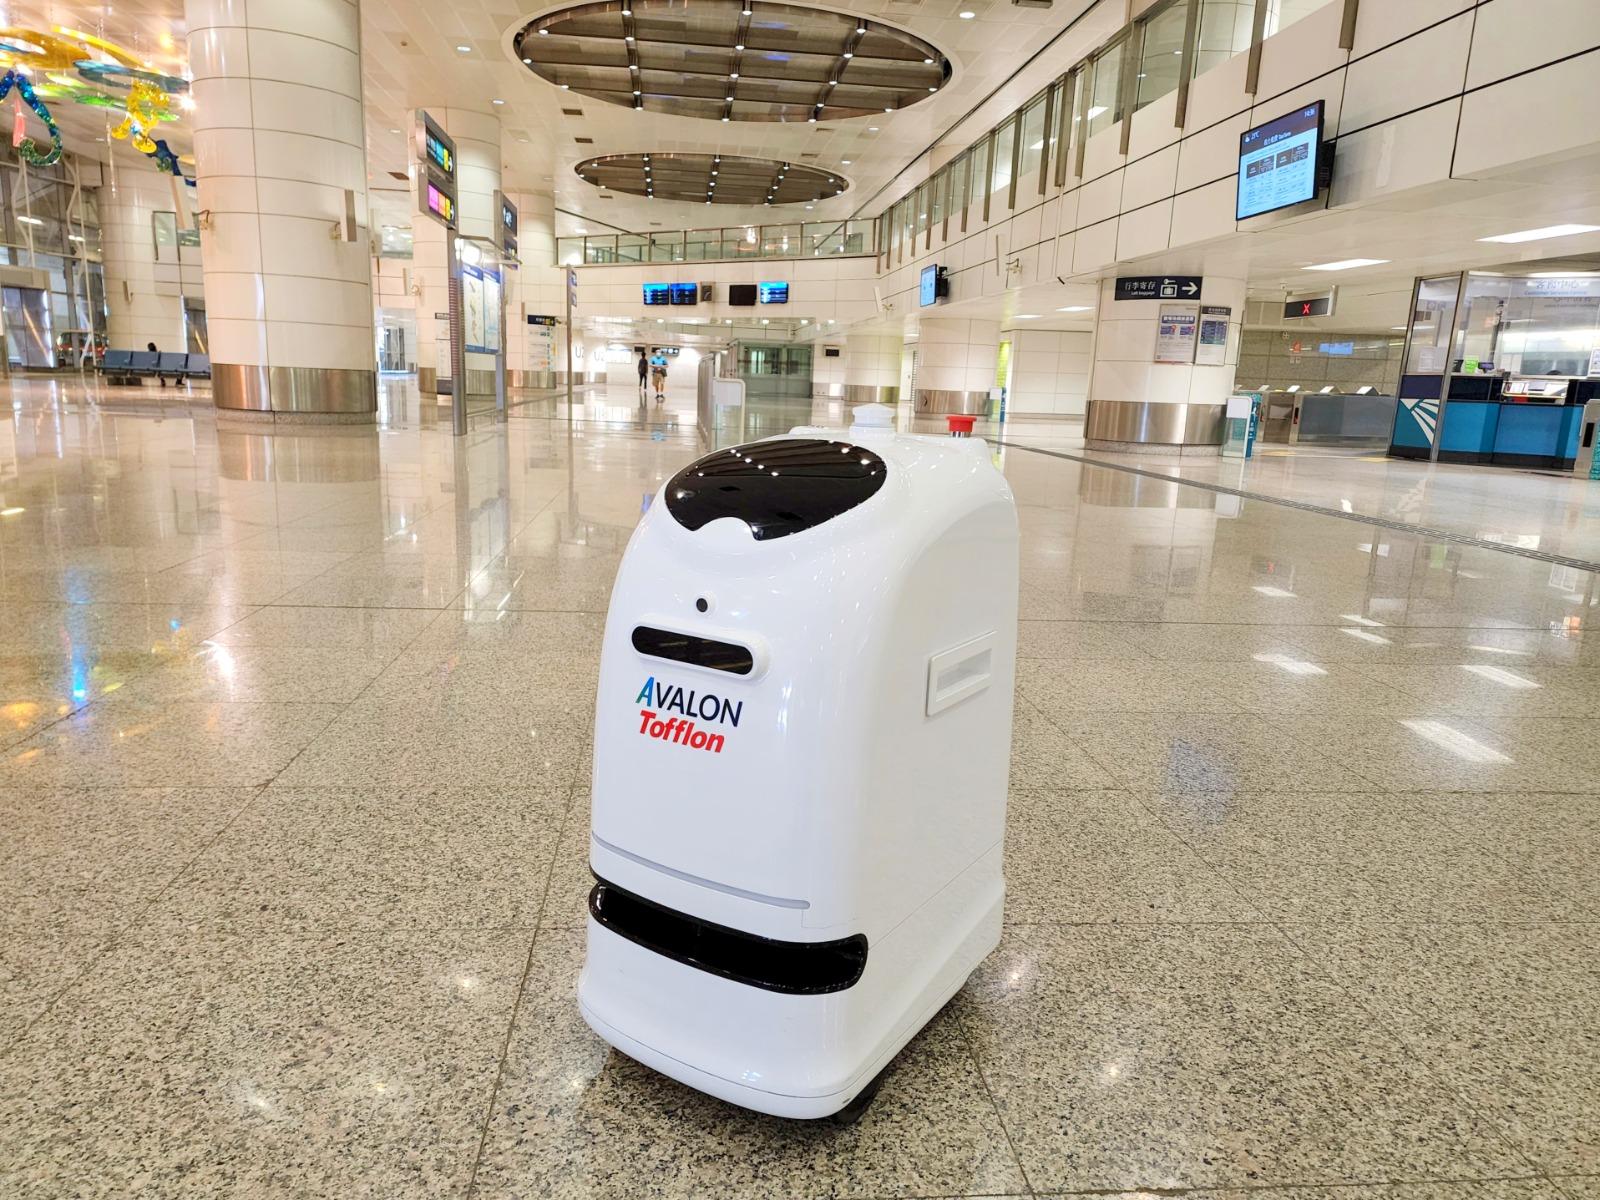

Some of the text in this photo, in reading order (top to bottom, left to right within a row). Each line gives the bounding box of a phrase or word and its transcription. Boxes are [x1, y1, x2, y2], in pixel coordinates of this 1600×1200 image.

[1124, 281, 1156, 290] 行李寄存
[635, 676, 743, 727] AVALON
[640, 710, 725, 753] Tofflon
